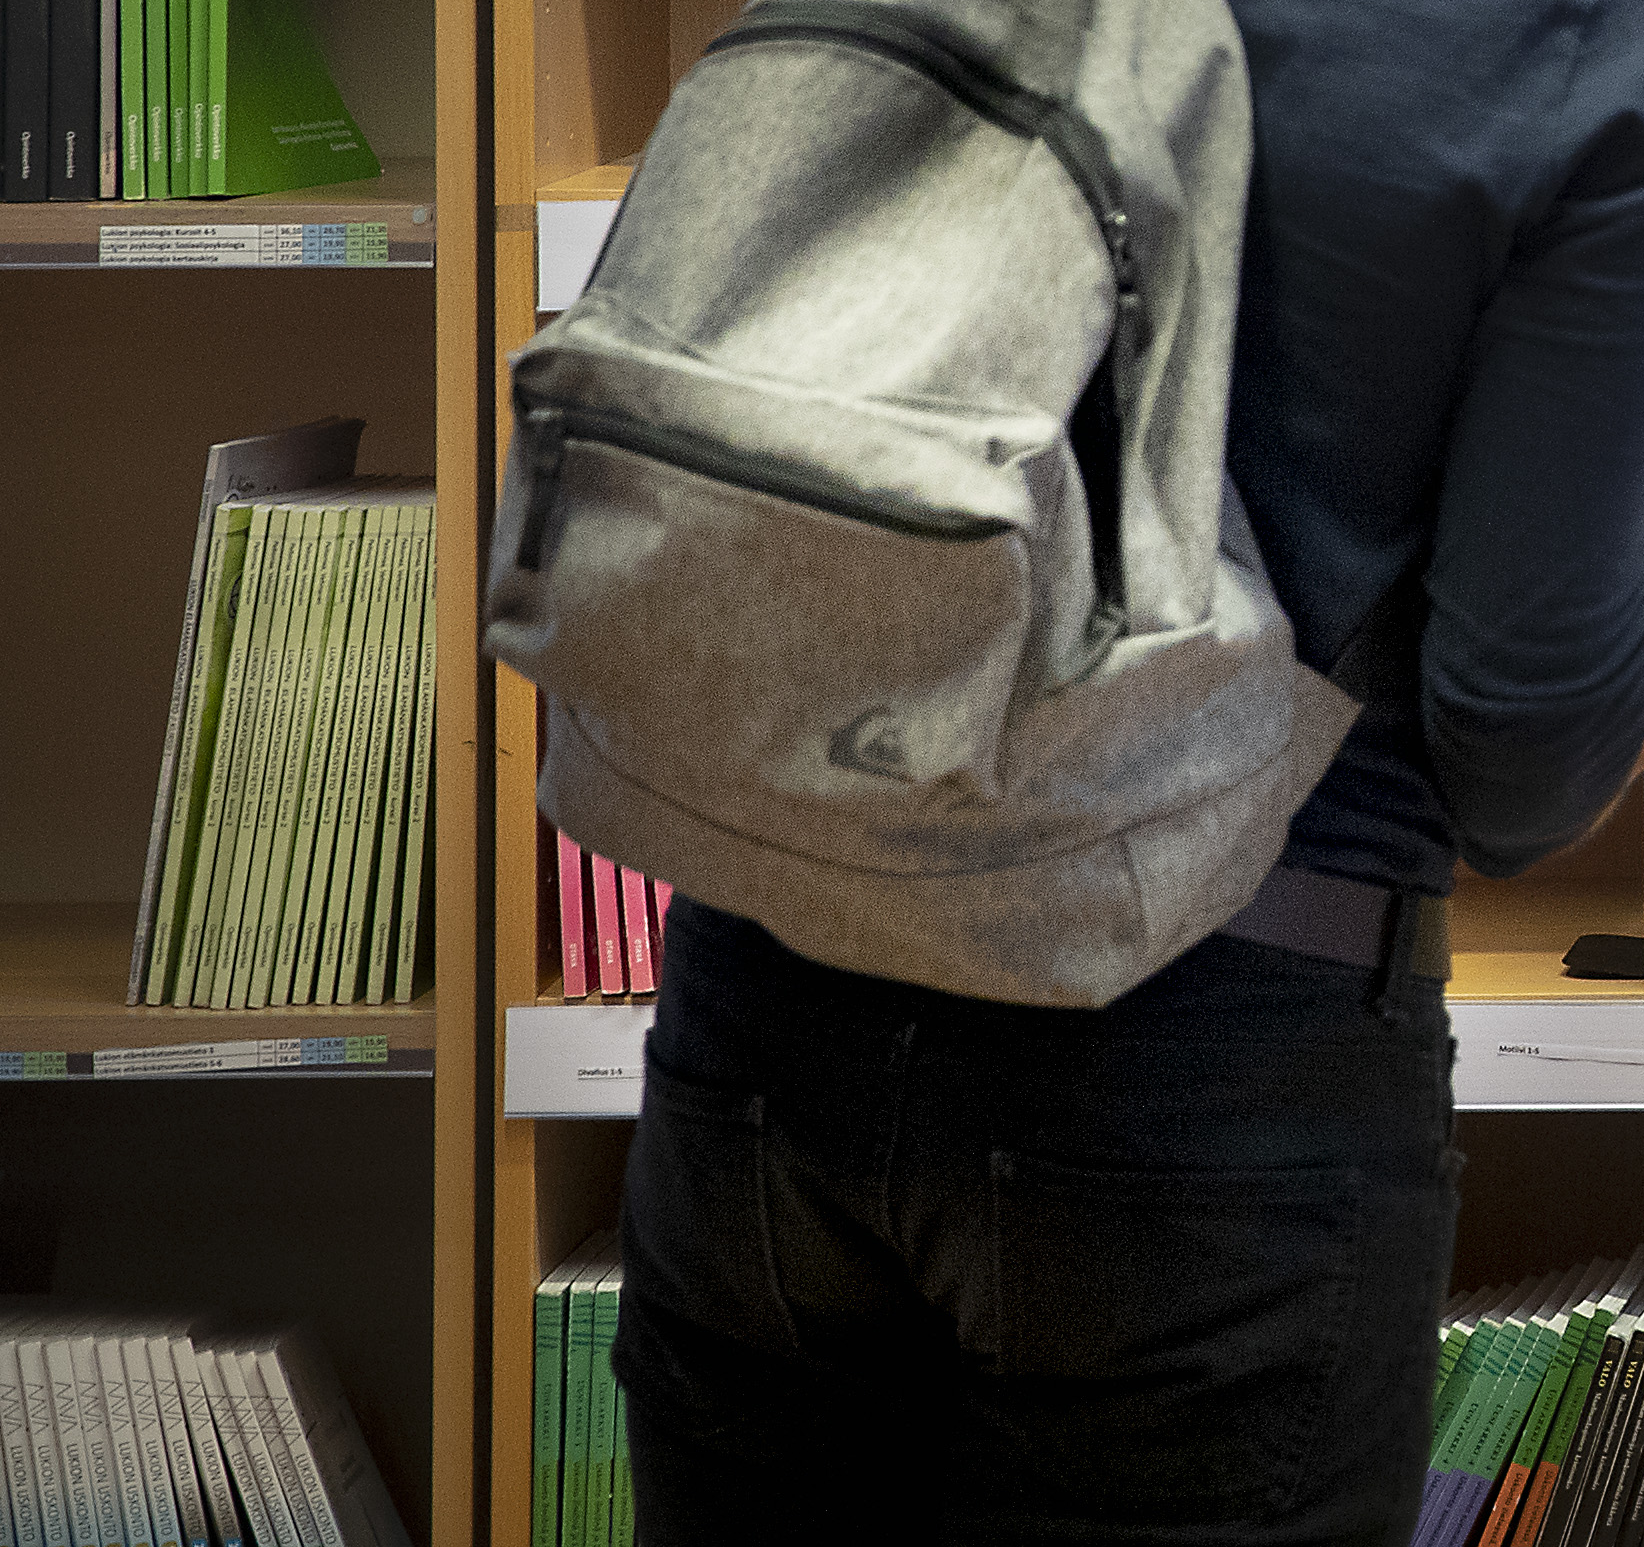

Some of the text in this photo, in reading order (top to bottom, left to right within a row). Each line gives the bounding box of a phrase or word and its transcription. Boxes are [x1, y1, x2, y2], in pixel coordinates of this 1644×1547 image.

[1499, 1045, 1526, 1054] Motiivi
[295, 1453, 336, 1545] LUKION USKONTO
